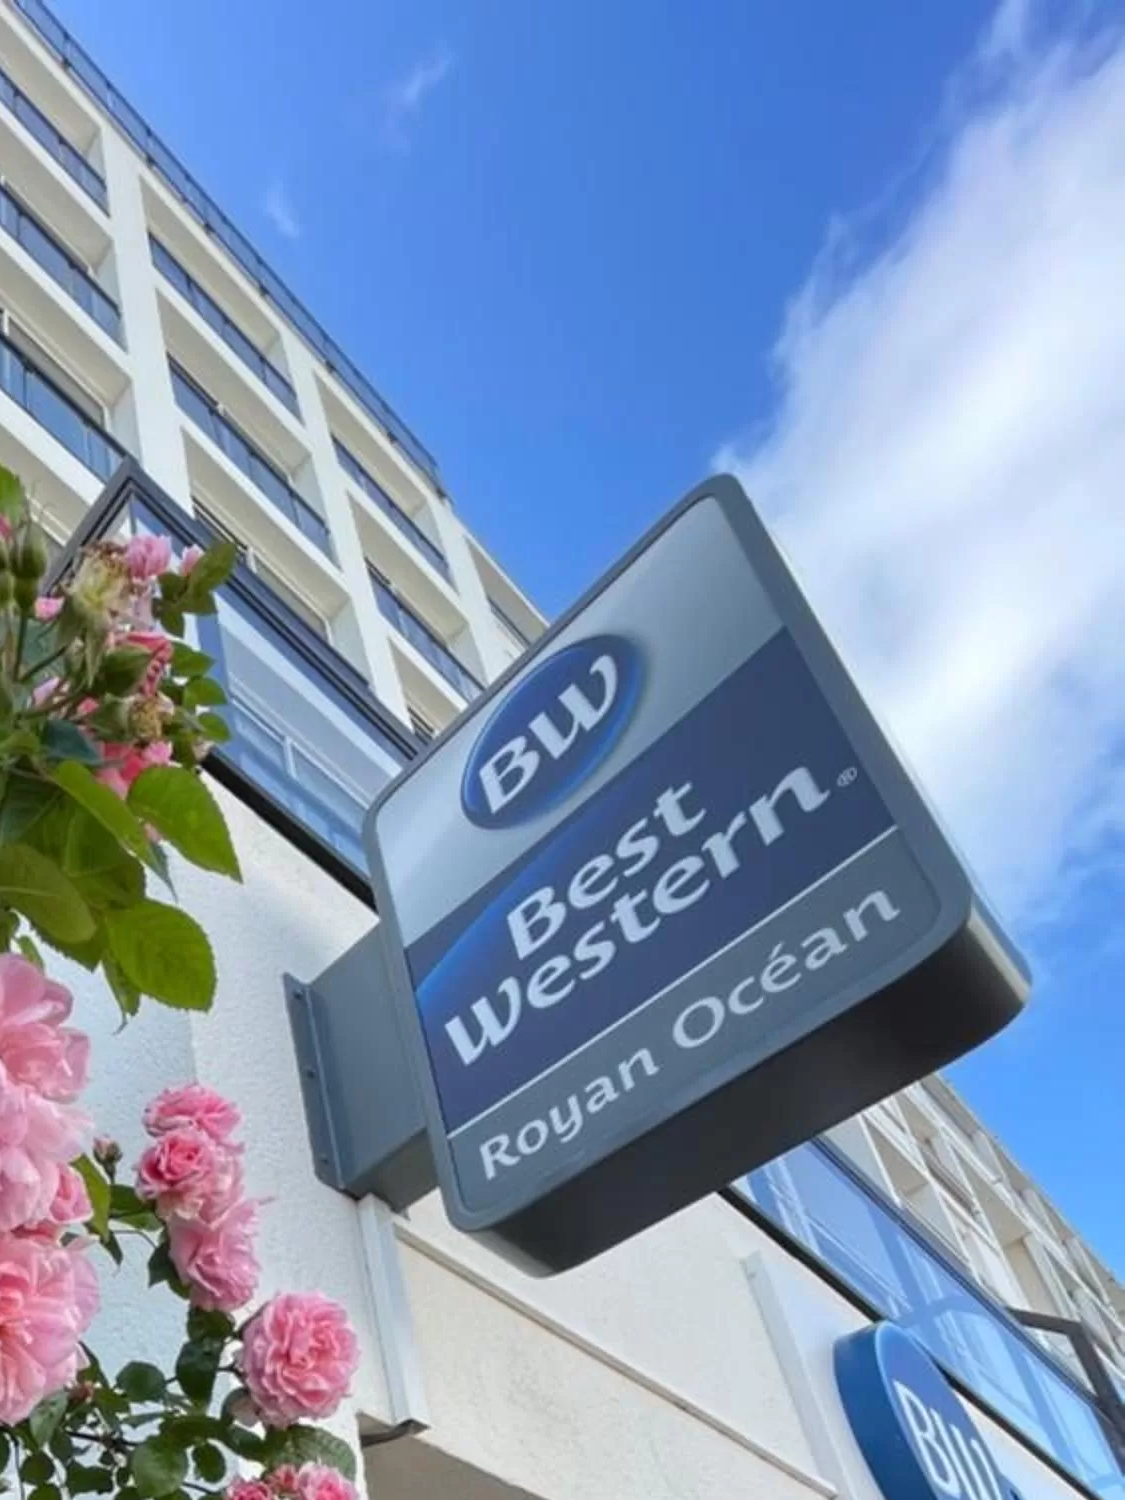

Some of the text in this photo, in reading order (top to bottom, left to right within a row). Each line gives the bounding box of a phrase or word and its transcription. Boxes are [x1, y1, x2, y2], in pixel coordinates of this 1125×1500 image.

[479, 655, 617, 814] BW
[506, 781, 707, 960] Best
[479, 889, 901, 1180] Royan Océan
